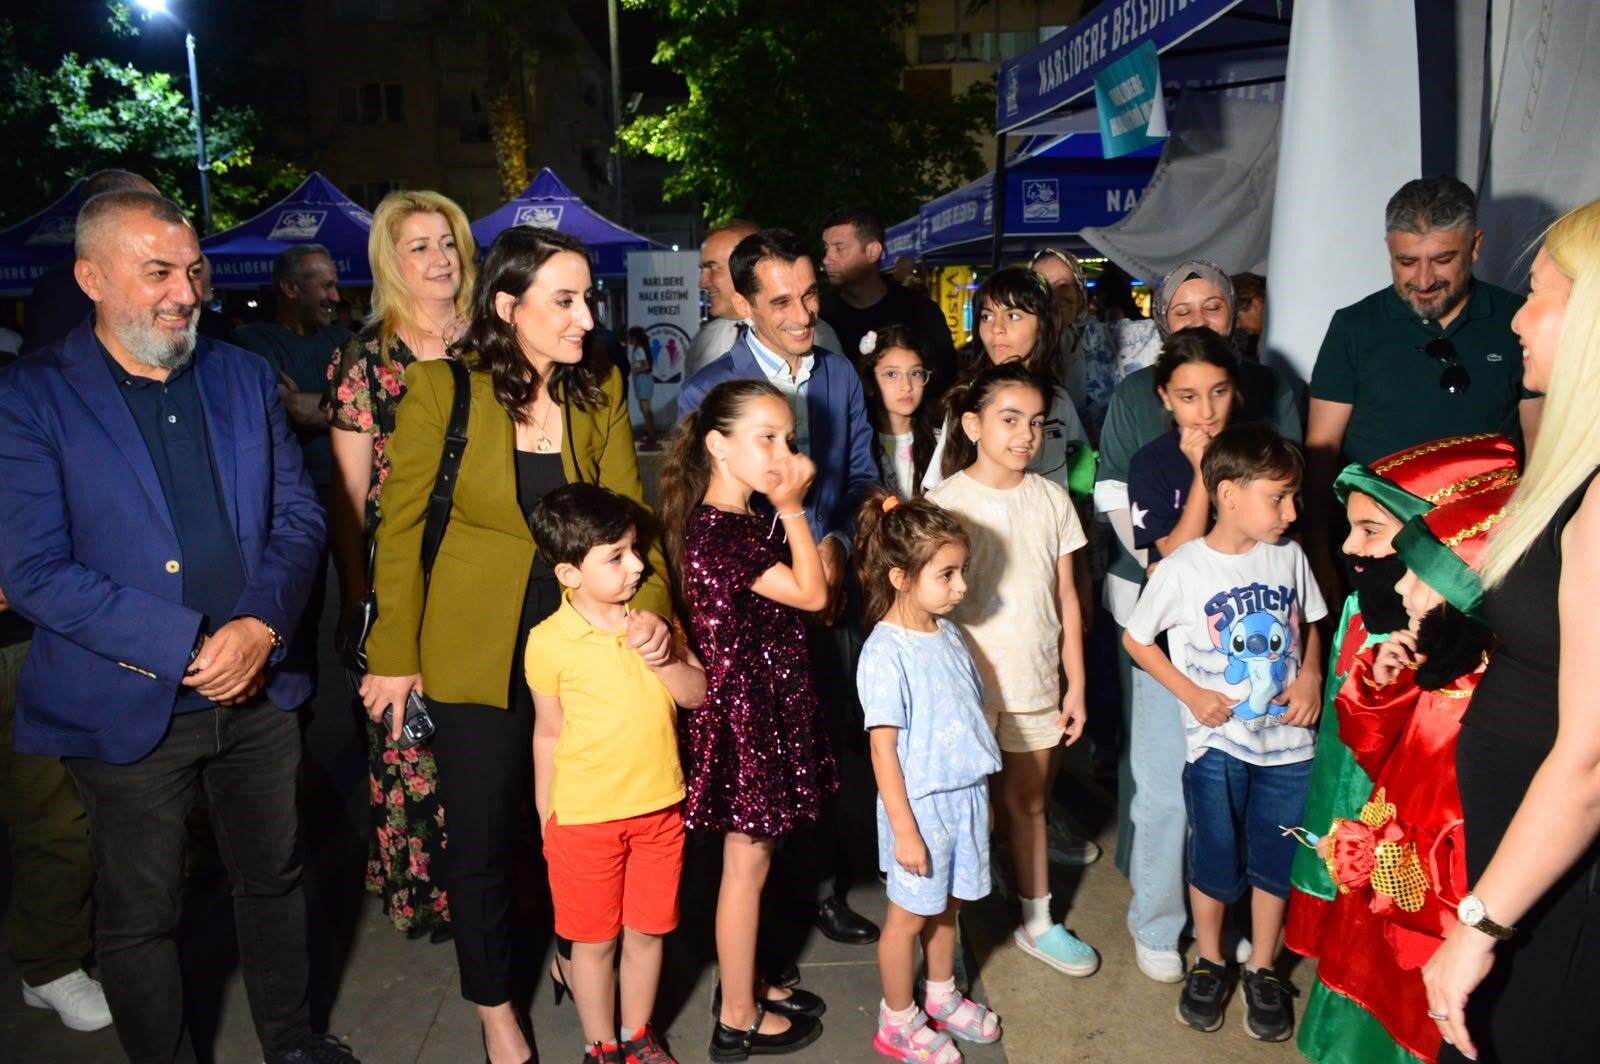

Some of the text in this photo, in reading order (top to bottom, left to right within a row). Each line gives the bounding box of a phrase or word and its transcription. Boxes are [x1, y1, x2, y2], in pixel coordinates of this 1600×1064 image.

[1038, 15, 1108, 96] NARLIDERE
[1106, 188, 1146, 213] NA
[642, 276, 685, 287] NARLIDERE
[638, 291, 659, 301] HALK
[647, 304, 681, 316] MERKEZİ
